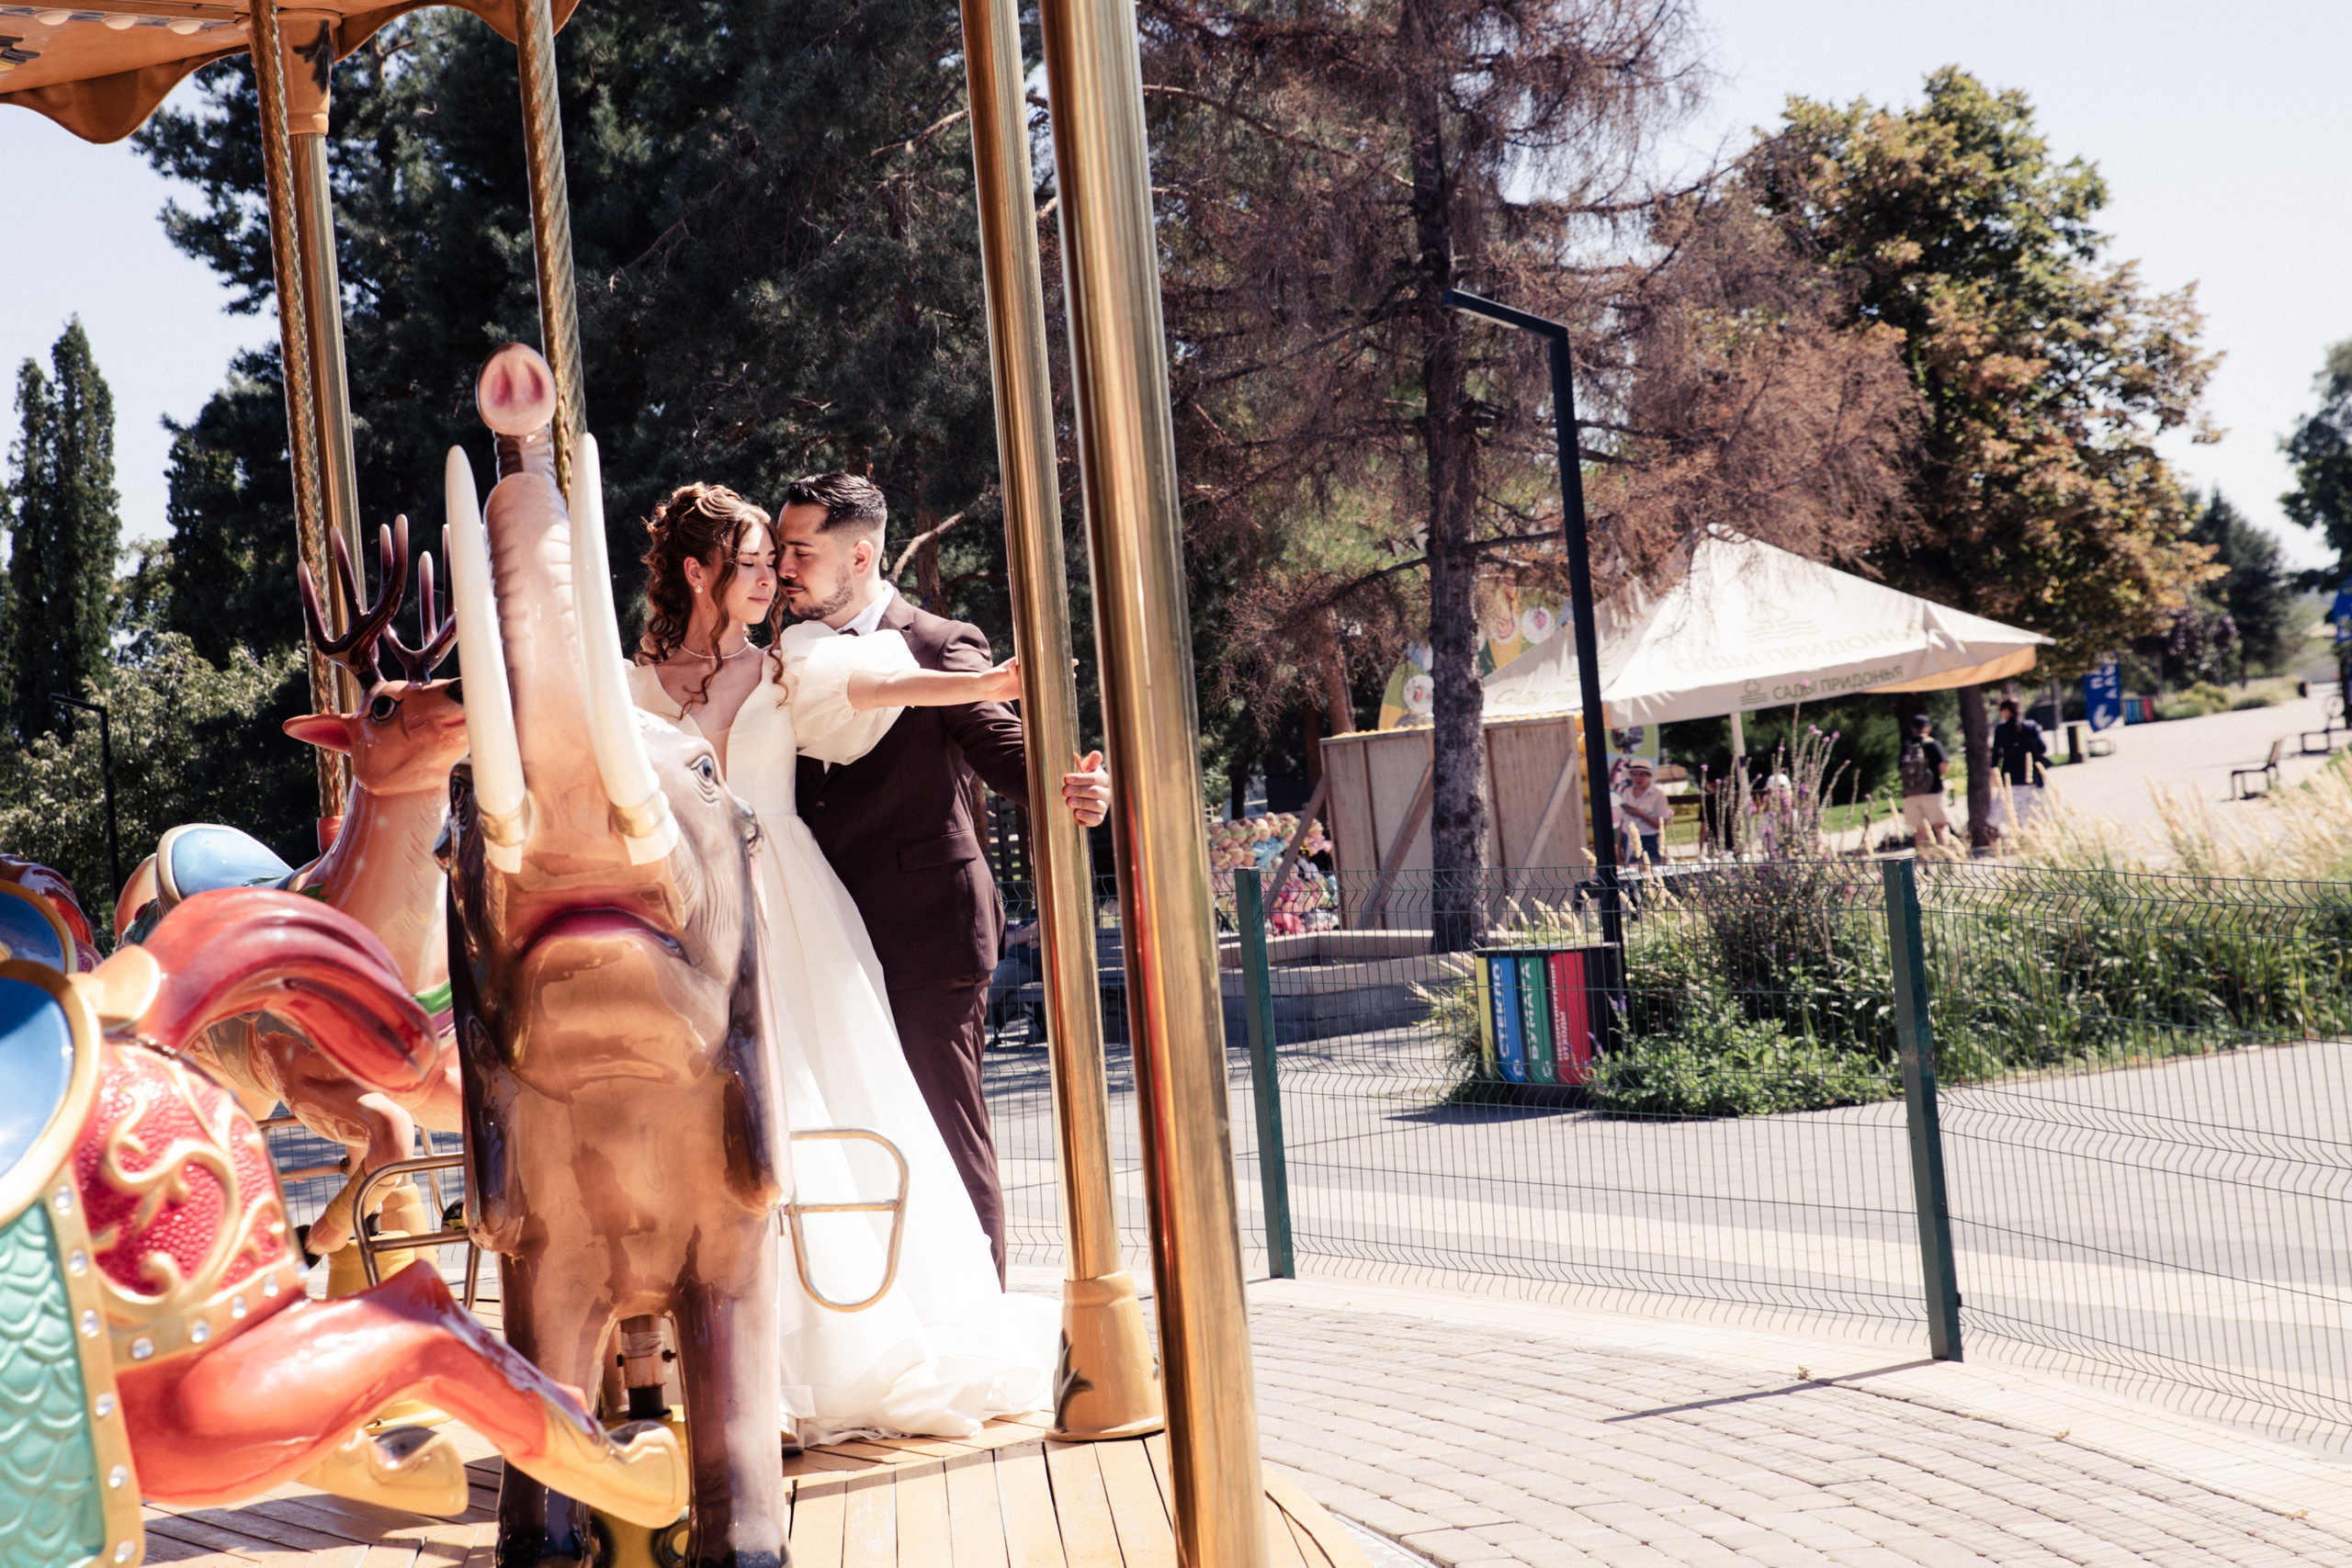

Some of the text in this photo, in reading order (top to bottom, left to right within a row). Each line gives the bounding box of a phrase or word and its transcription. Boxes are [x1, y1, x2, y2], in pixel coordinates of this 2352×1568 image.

[1772, 665, 1904, 701] САДЫ ПРИДОНЬЯ
[1492, 963, 1510, 1058] СТЕКЛО
[1521, 962, 1540, 1060] БУМАГА
[1550, 963, 1564, 1061] НЕСОРТИРУЕМЫЕ
[1560, 1011, 1570, 1061] ОТХОДЫ
